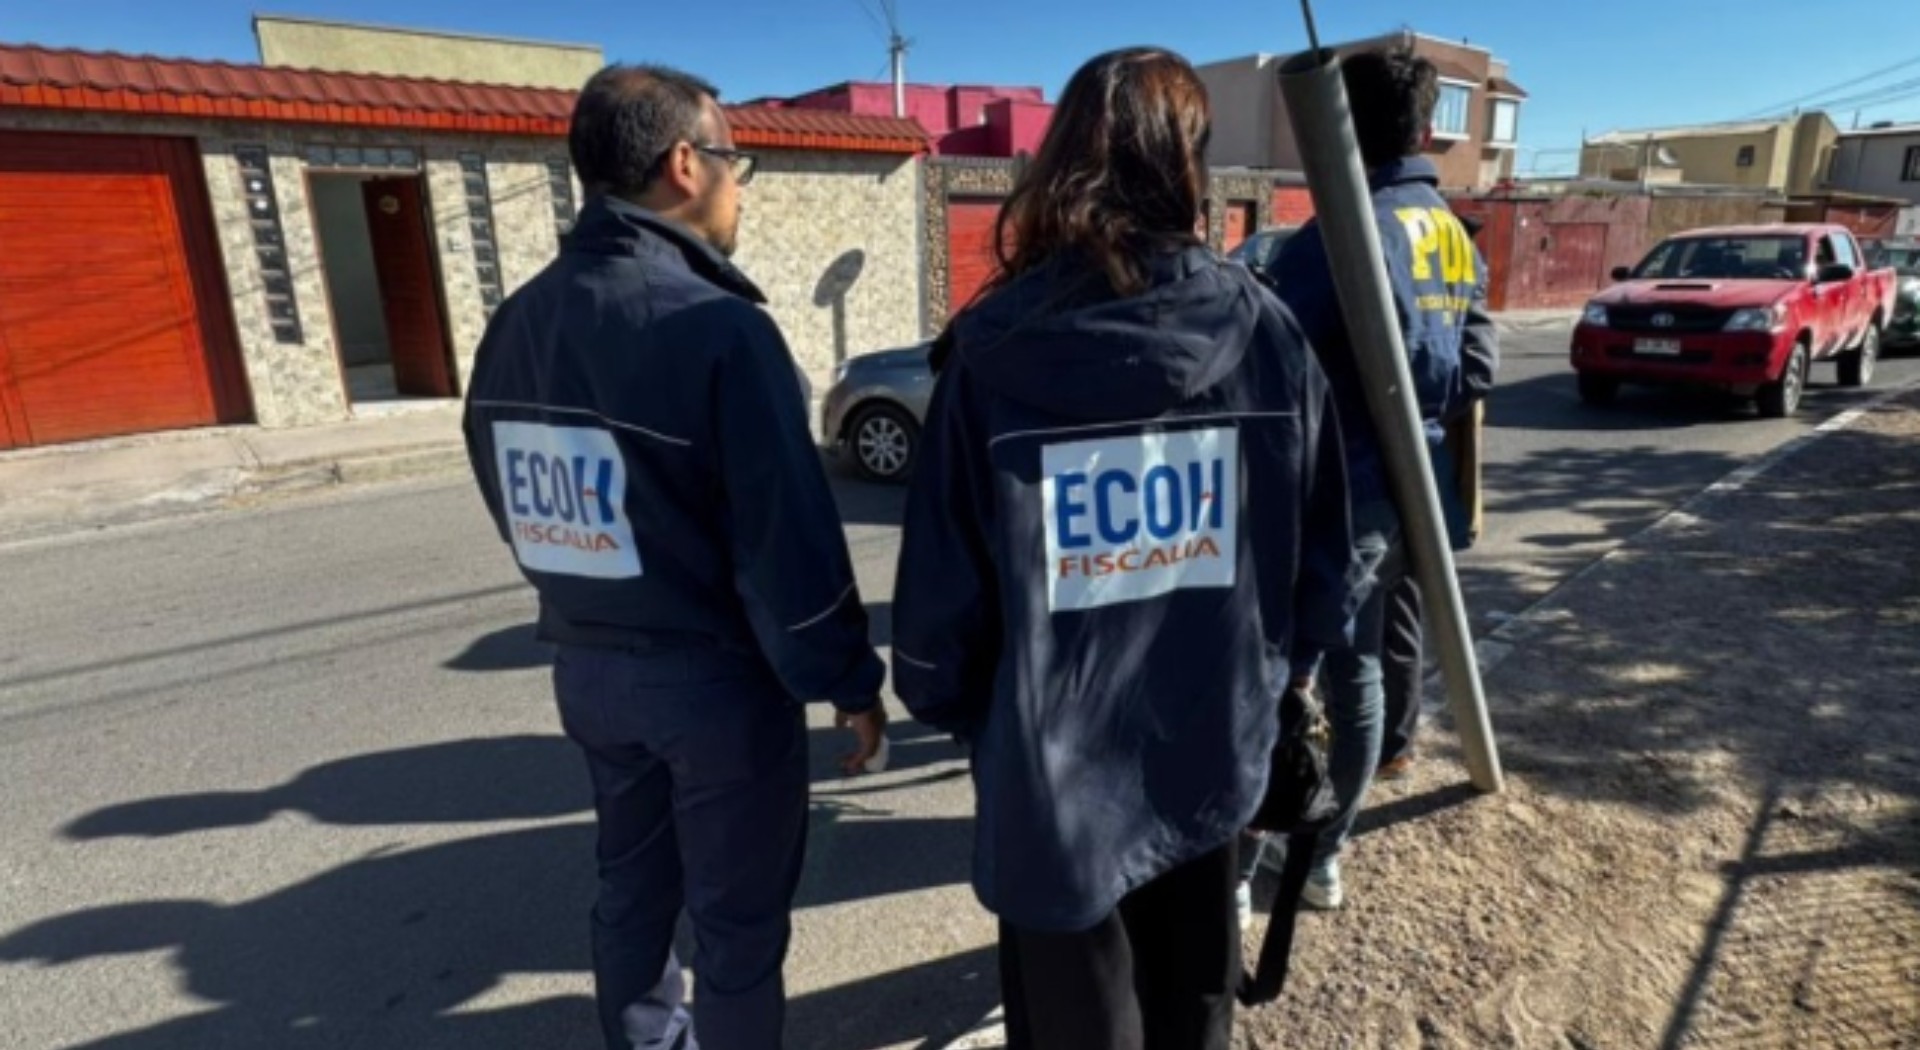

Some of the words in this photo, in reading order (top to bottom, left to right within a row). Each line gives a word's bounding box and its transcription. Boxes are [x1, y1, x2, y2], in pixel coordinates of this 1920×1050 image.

[1392, 206, 1476, 284] PDI
[506, 449, 615, 526] ECOH
[1055, 459, 1223, 549] ECOH
[515, 521, 620, 552] FISCALIA
[1058, 536, 1220, 578] FISCALIA
